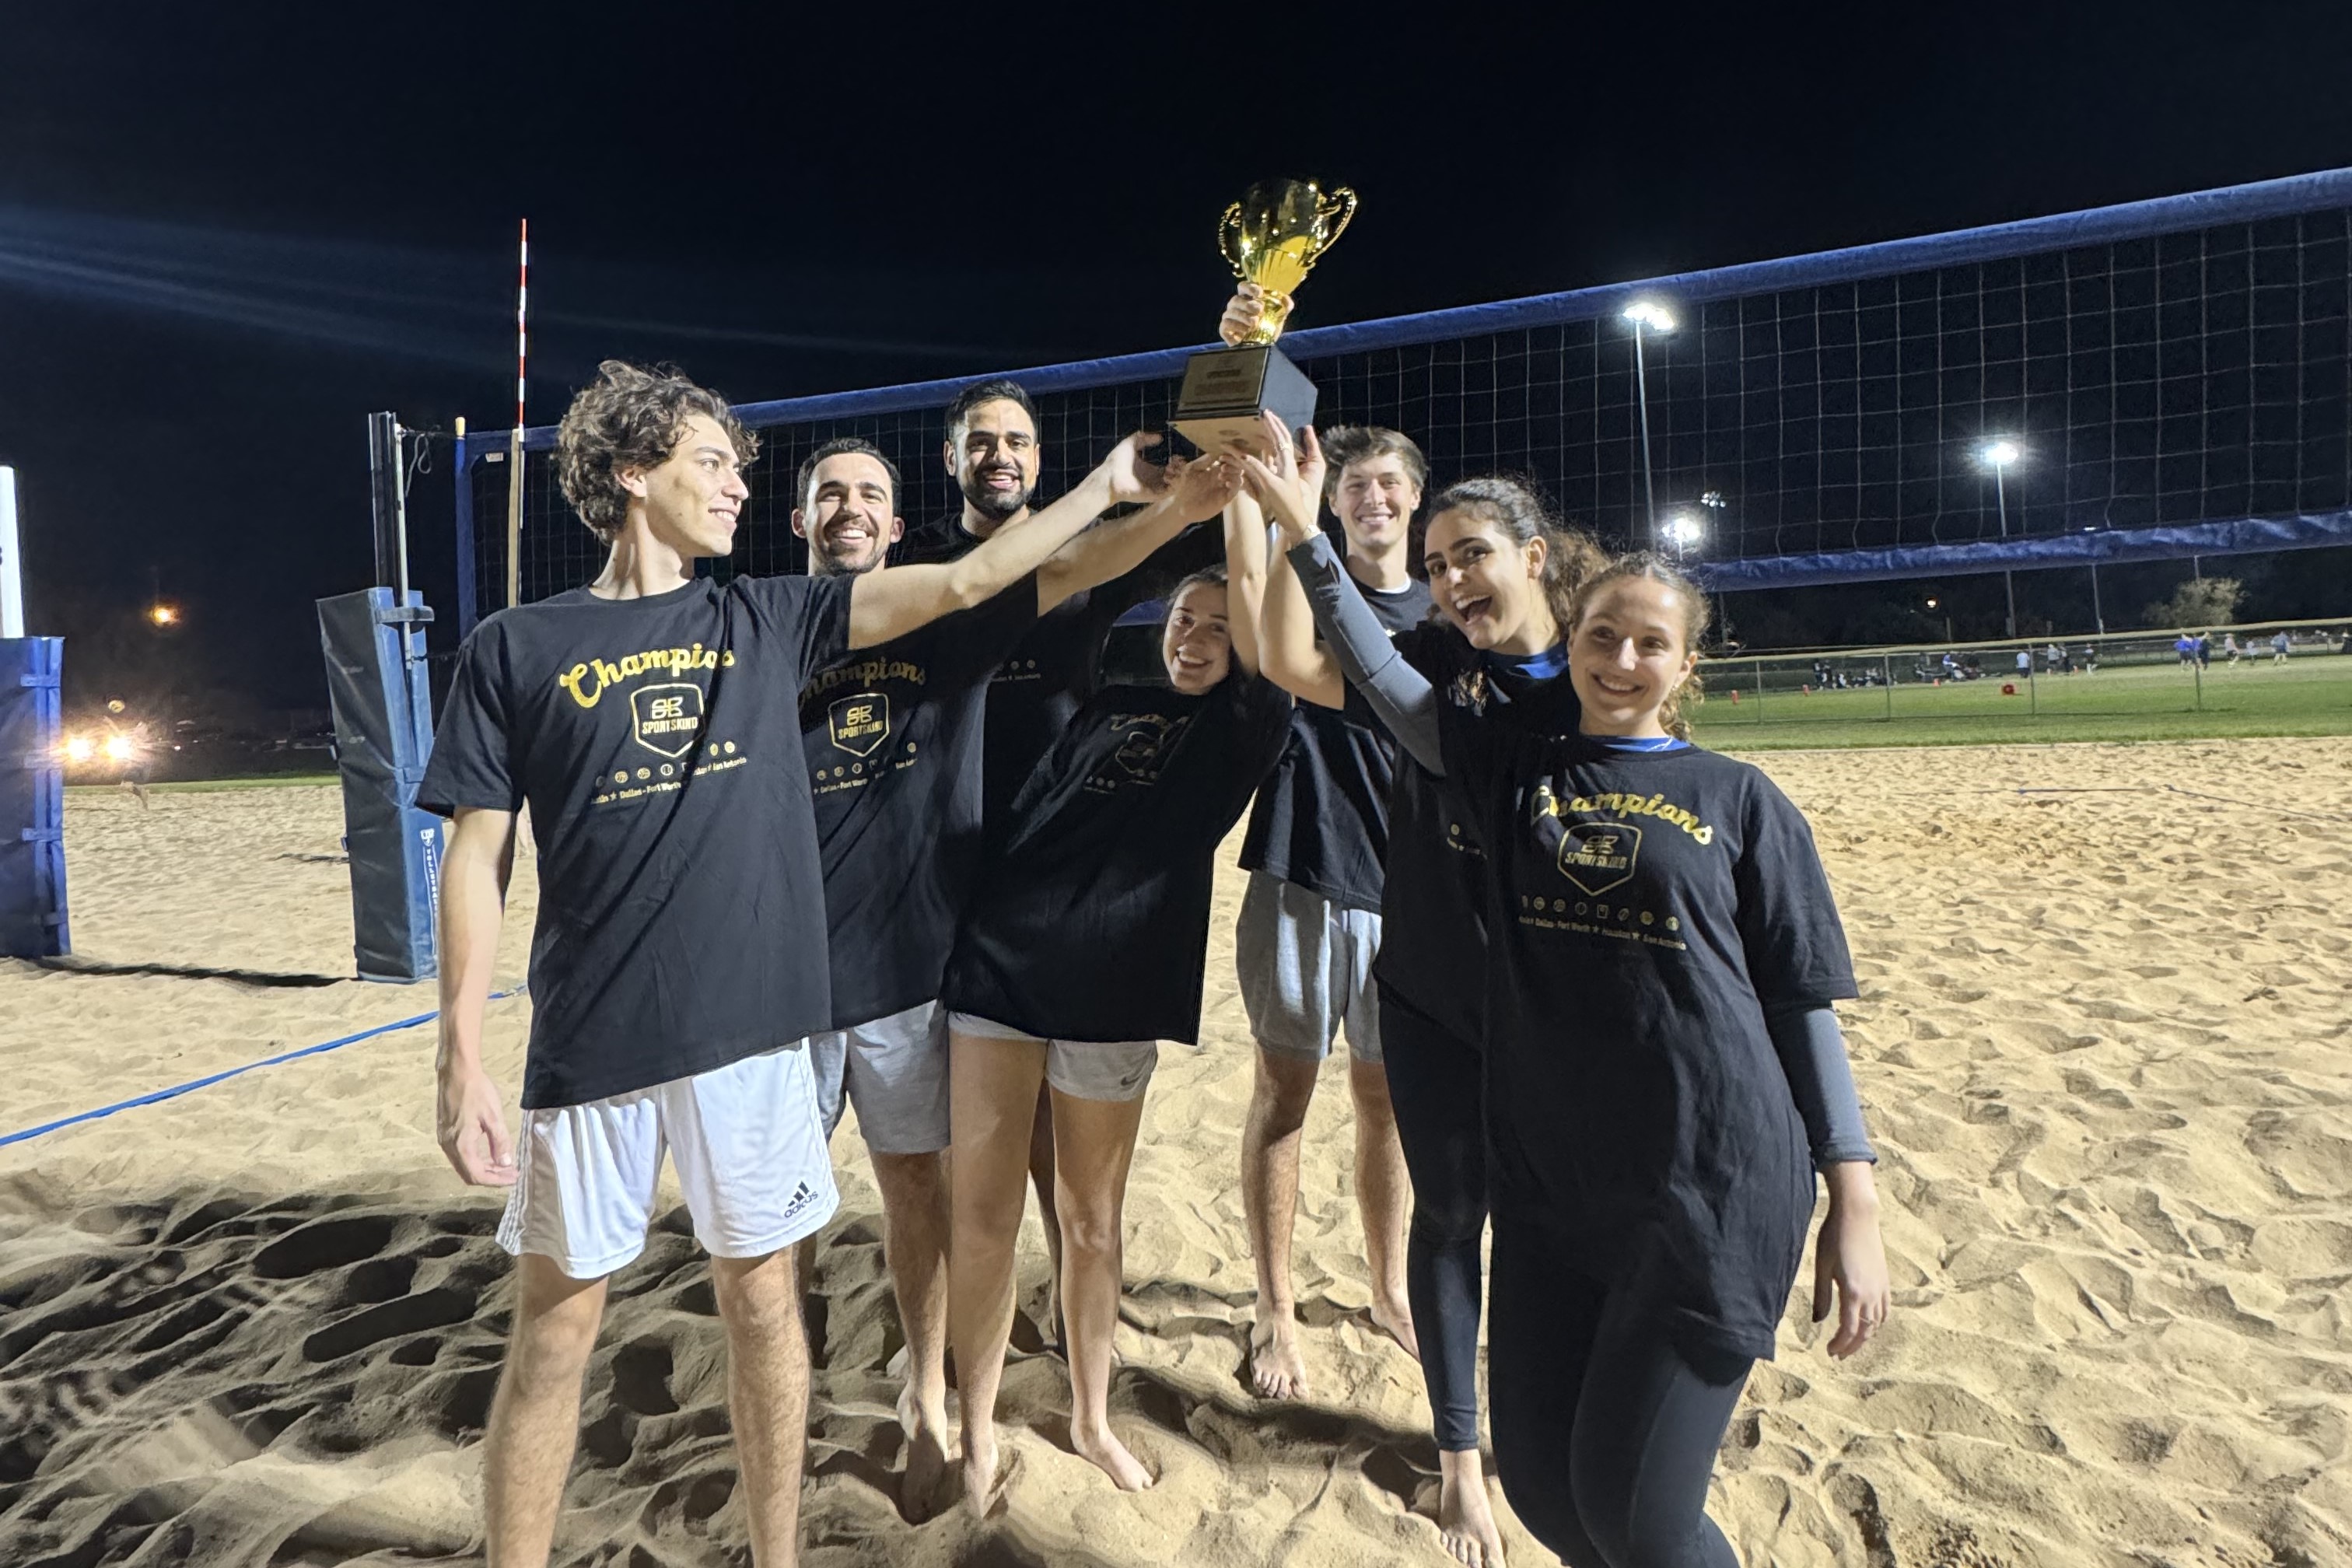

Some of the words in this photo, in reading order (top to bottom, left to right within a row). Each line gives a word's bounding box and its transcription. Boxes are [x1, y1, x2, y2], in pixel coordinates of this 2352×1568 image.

[559, 642, 735, 708] Champios
[642, 716, 698, 734] SPORTSKIND
[838, 720, 884, 740] SPORTSKIND
[1565, 851, 1628, 870] SPORTSKIND
